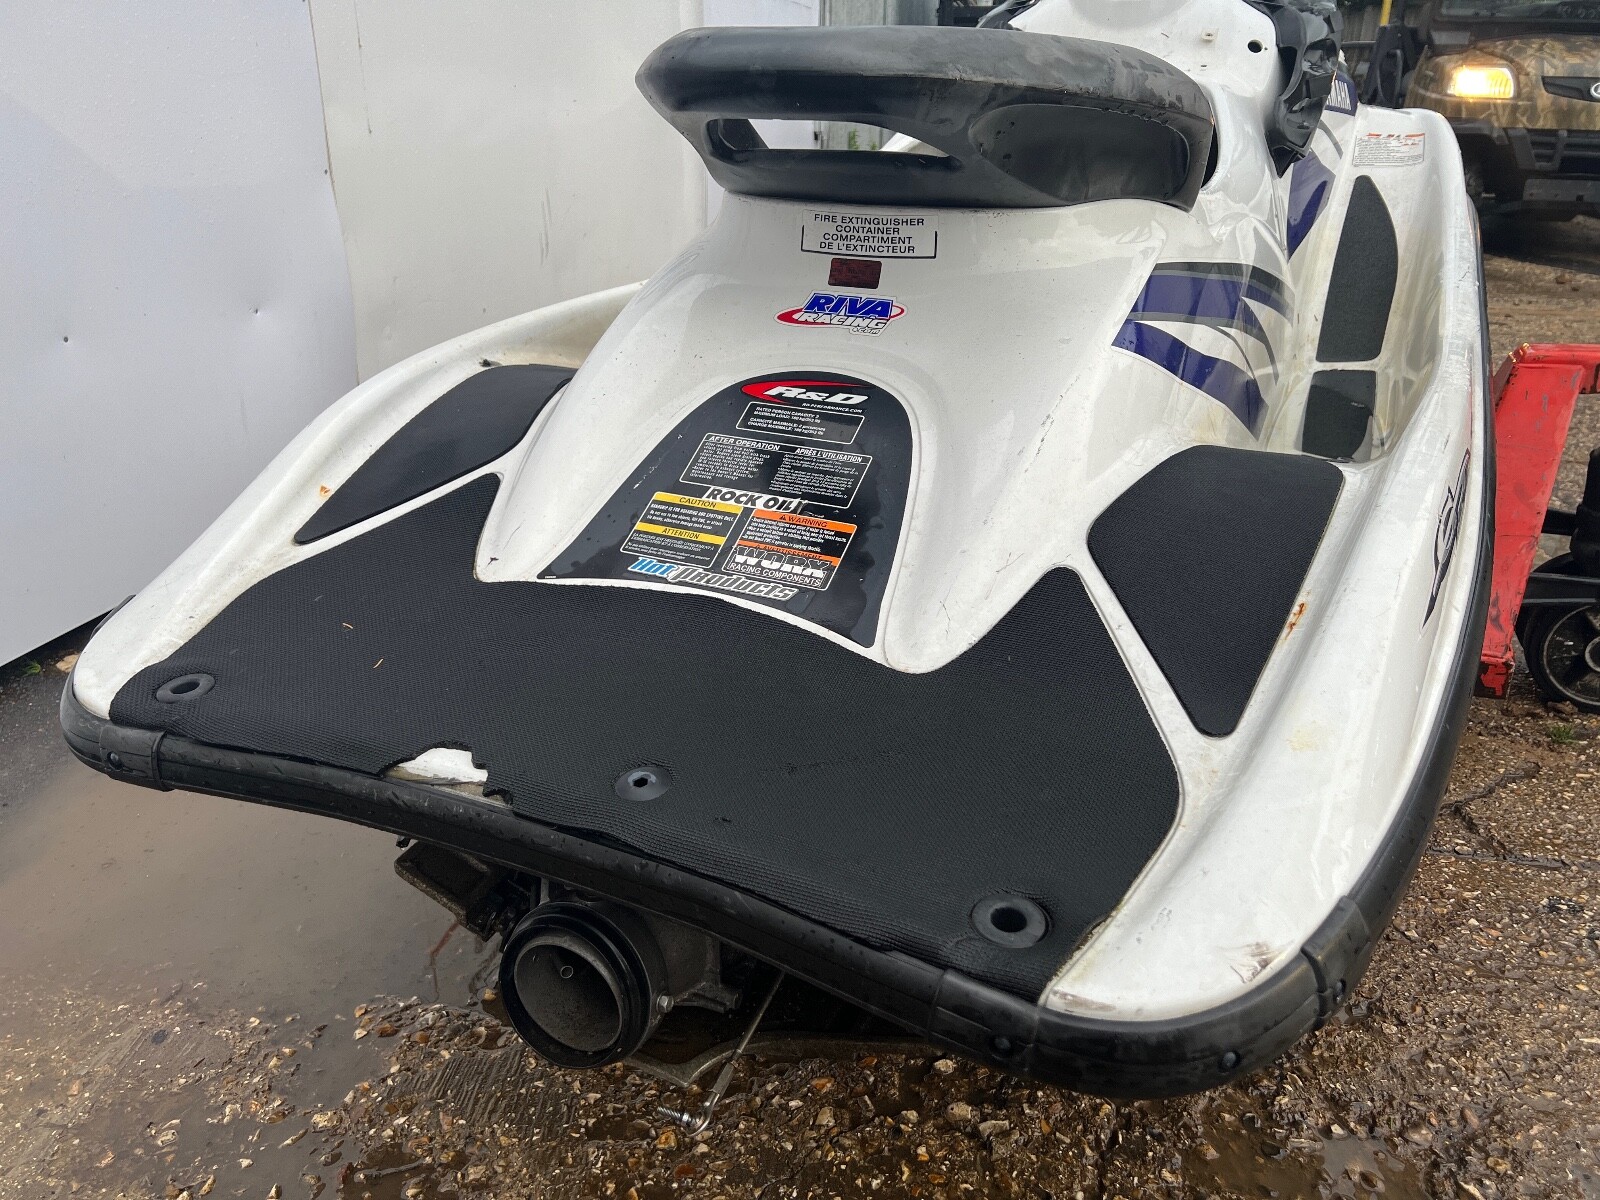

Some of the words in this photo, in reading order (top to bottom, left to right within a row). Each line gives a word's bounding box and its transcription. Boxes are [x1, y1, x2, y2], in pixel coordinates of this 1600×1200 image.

[814, 214, 838, 223] FIRE
[842, 216, 924, 226] EXTINGUISHER
[836, 225, 900, 235] CONTAINER
[823, 232, 912, 244] COMPARTIMENT
[820, 242, 834, 250] DE
[838, 243, 915, 254] L'EXTINCTEUR
[802, 292, 894, 319] RIVA
[798, 312, 888, 329] RACING
[763, 386, 869, 404] R&D
[709, 436, 734, 444] AFTER
[736, 440, 780, 450] OPERATION
[794, 448, 817, 456] APRÈS
[817, 451, 862, 462] L'UTILISATION
[680, 496, 716, 508] CAUTION
[705, 488, 762, 507] ROCK
[762, 496, 795, 511] OIL
[788, 516, 828, 528] WARNING
[662, 528, 700, 540] ATTENTION
[628, 556, 678, 578] Hot
[733, 546, 831, 578] WORX
[728, 562, 762, 574] RACING
[762, 568, 822, 587] COMPONENTS
